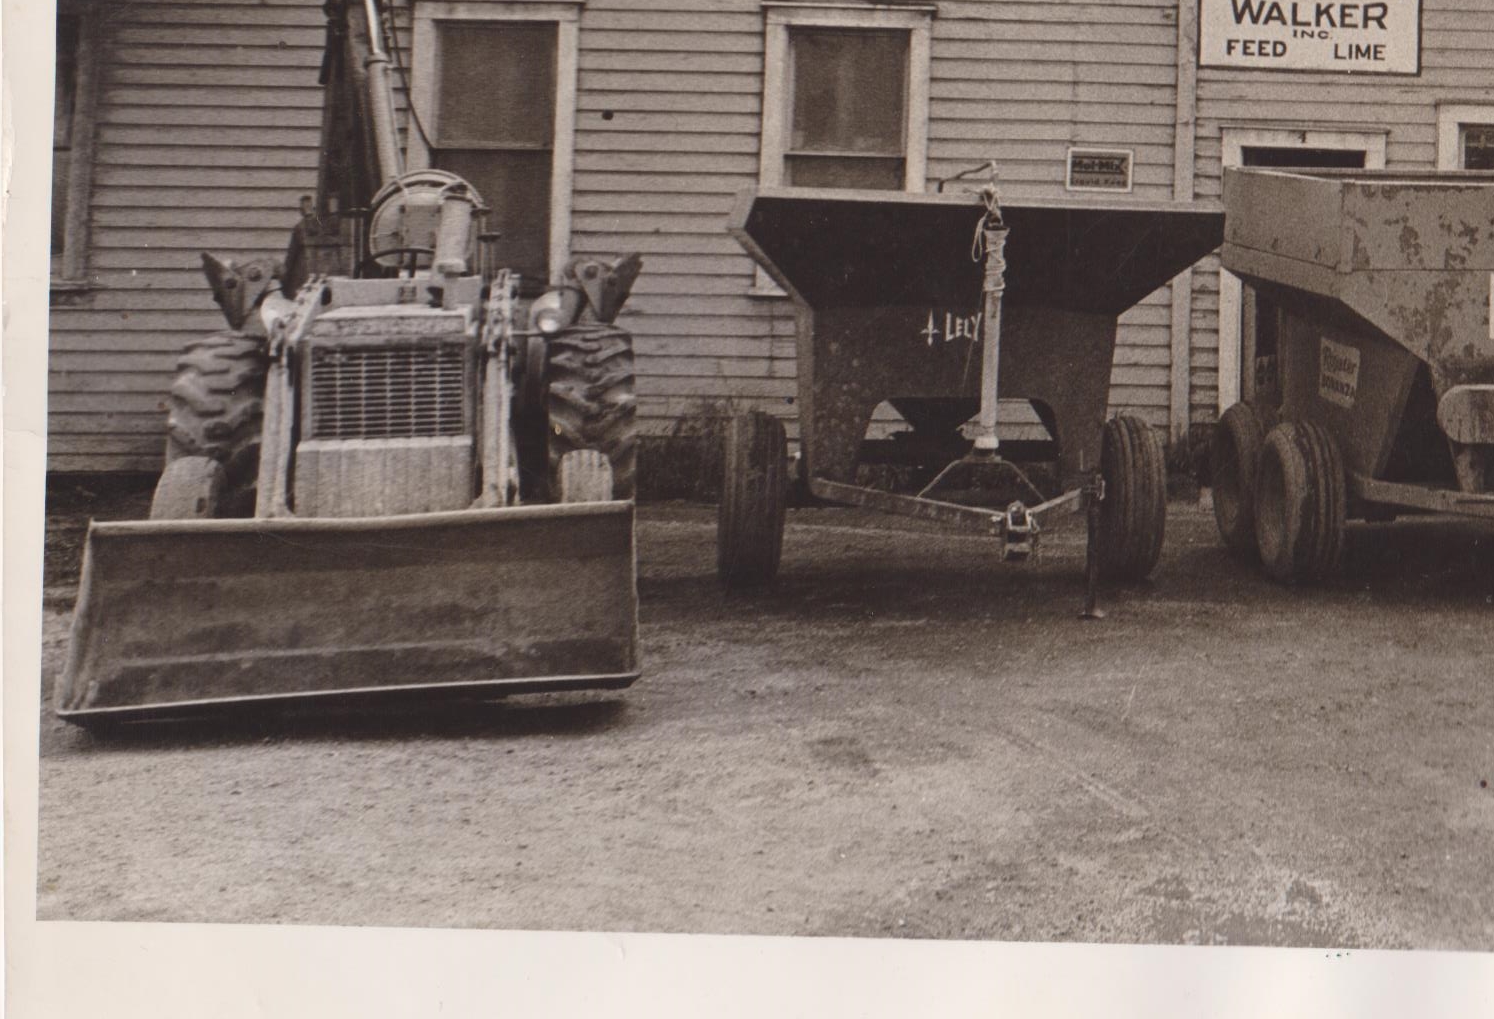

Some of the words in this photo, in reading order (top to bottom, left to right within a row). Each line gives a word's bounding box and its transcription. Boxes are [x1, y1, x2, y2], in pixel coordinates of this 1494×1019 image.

[1292, 30, 1333, 40] INC.
[1226, 39, 1287, 58] FEED
[1334, 43, 1386, 61] LIME
[945, 312, 982, 342] LELY
